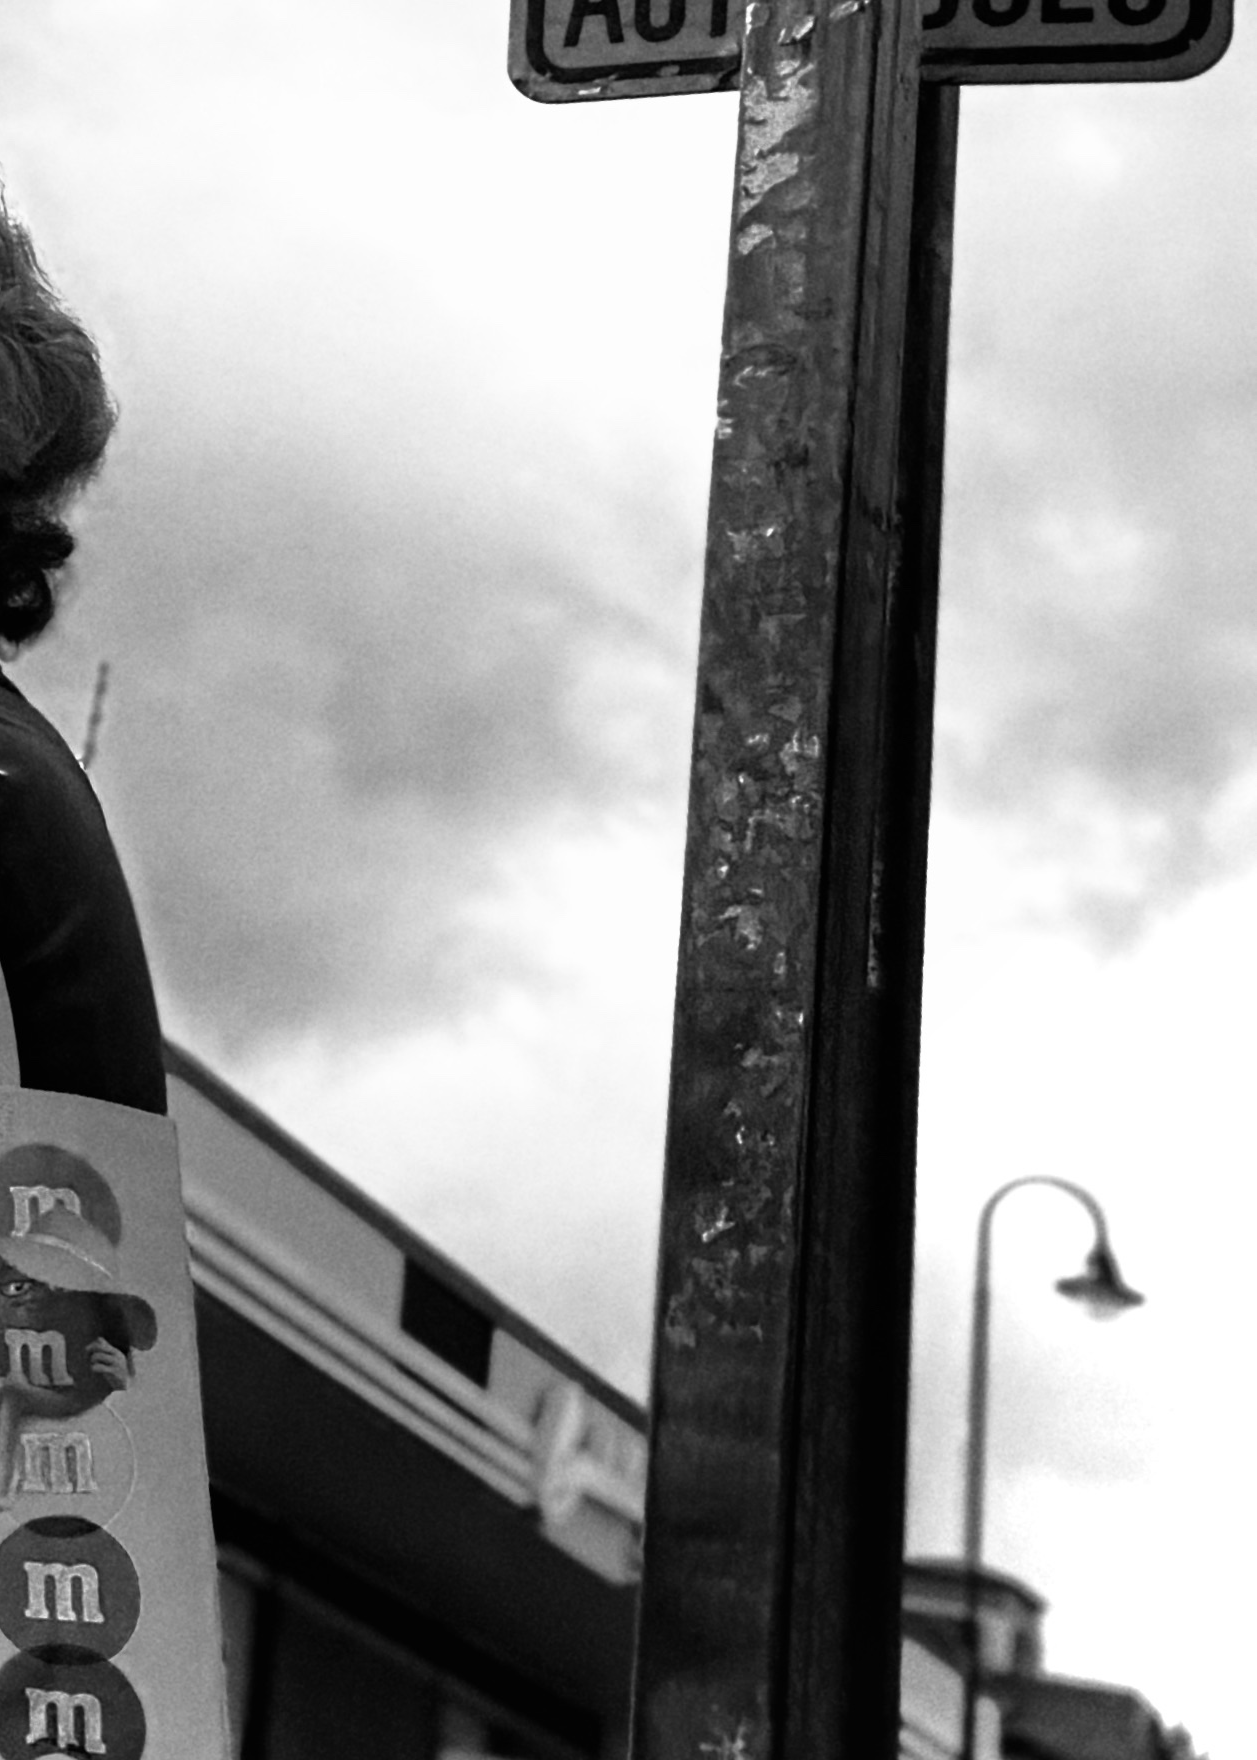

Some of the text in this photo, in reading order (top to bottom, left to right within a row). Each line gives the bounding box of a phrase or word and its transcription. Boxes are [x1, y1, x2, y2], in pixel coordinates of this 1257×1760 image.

[4, 1328, 74, 1387] m
[21, 1432, 97, 1495] m
[23, 1561, 105, 1624] m
[24, 1687, 107, 1755] m
